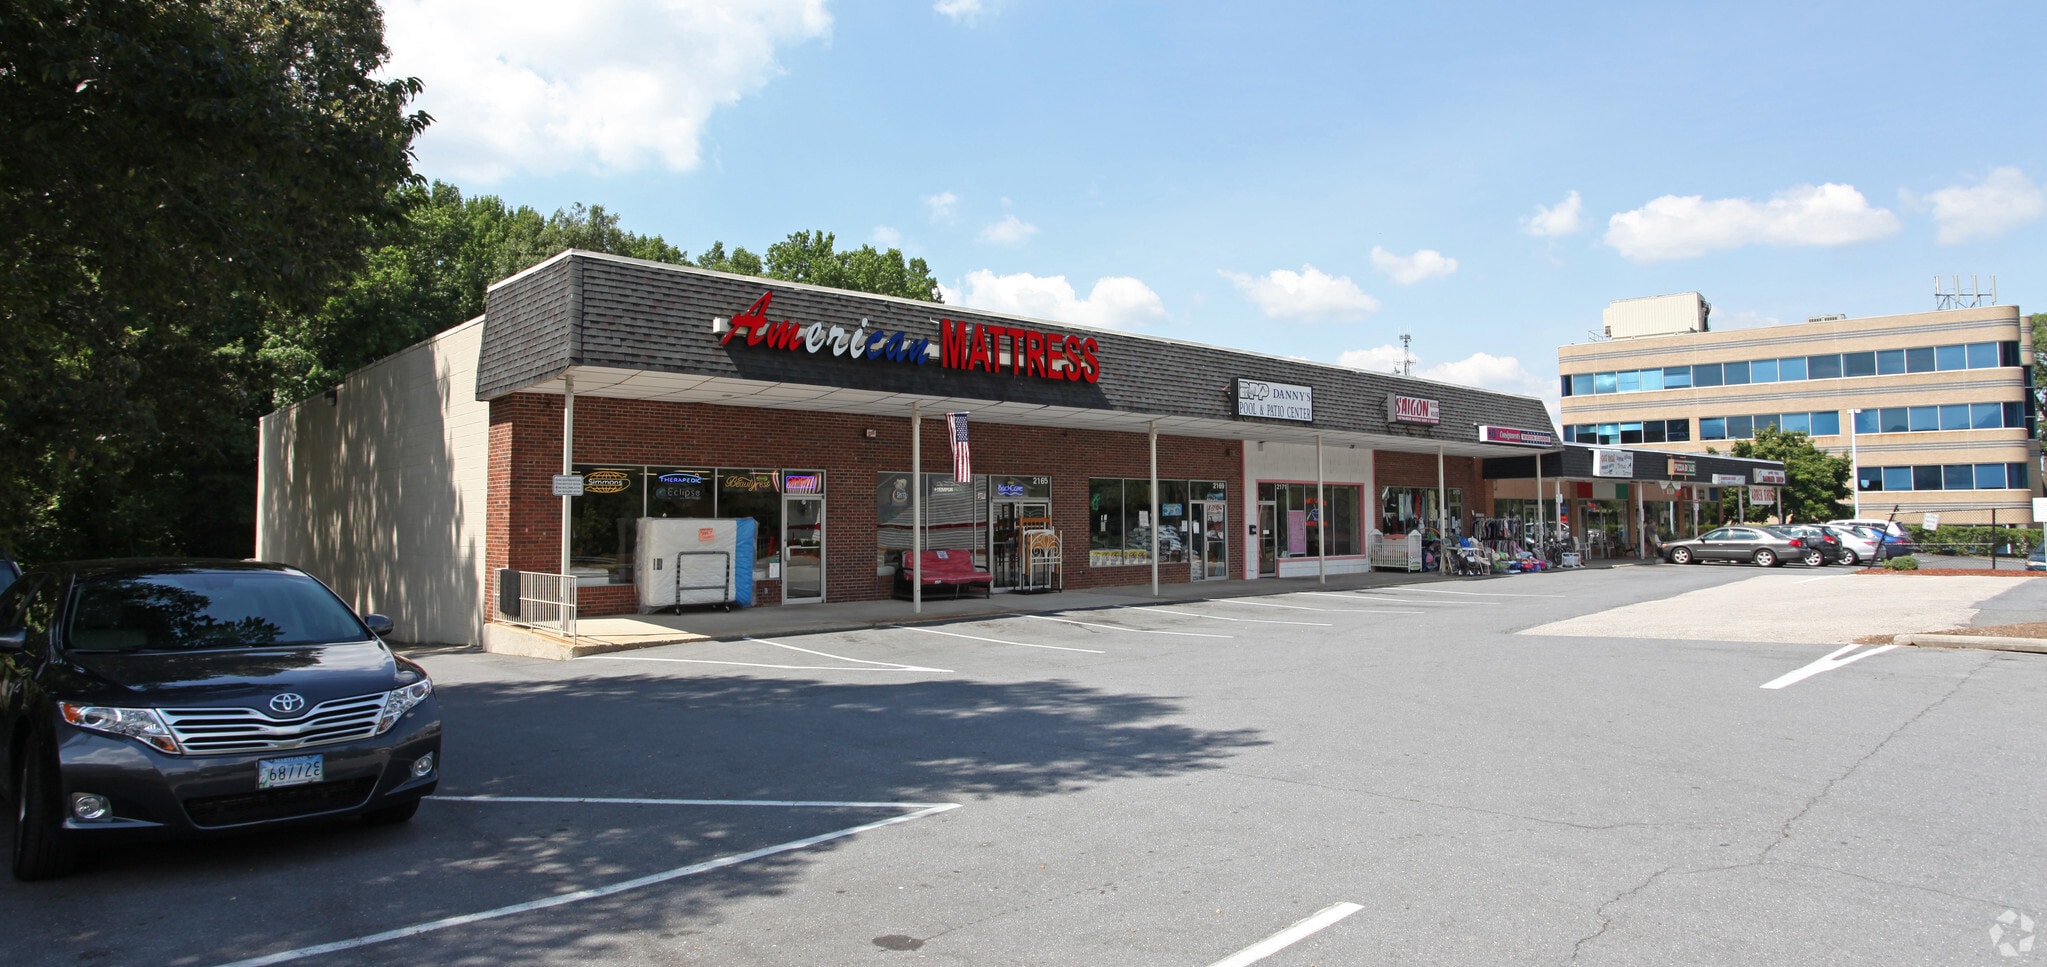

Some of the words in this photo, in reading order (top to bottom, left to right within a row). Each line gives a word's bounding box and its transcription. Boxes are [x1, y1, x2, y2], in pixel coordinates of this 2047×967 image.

[720, 290, 930, 366] American
[941, 317, 1100, 384] MATTRESS
[1273, 389, 1311, 402] DANNY'S
[1240, 402, 1257, 415] POOL
[1260, 404, 1265, 416] &
[1267, 404, 1285, 418] PATIO
[1287, 406, 1311, 420] CENTER
[1396, 397, 1429, 417] SAIGON
[588, 478, 623, 486] Simmons
[1033, 477, 1049, 485] 2165
[667, 487, 701, 498] Eclipse
